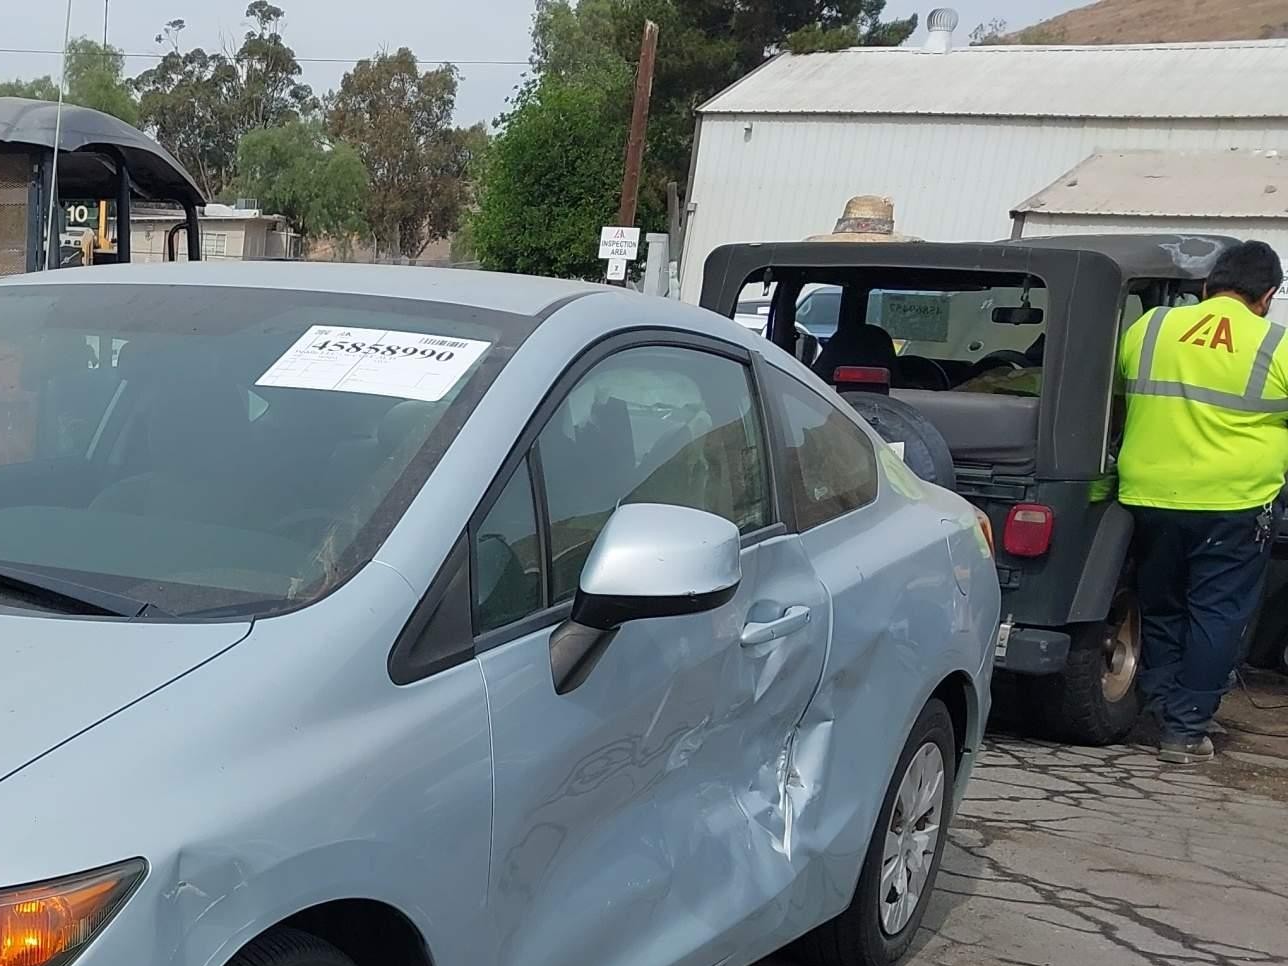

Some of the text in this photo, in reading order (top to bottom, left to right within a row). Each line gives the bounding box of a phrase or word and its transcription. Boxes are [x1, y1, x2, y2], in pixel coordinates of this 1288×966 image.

[67, 205, 88, 223] 10
[601, 240, 637, 248] INSPECTION
[610, 248, 627, 256] AREA
[312, 338, 455, 363] 45858990
